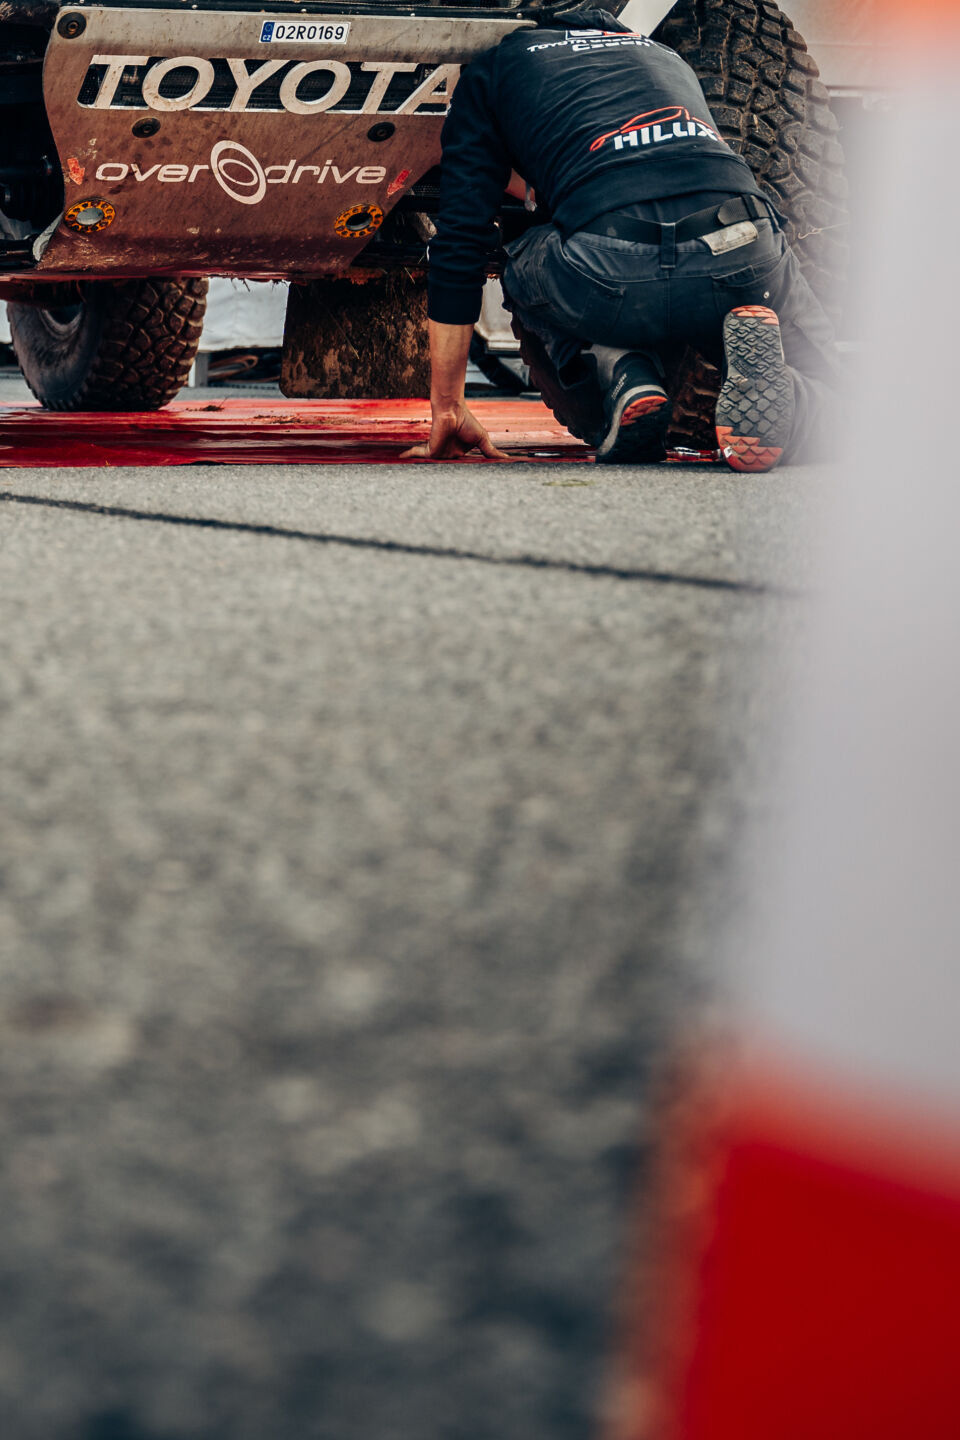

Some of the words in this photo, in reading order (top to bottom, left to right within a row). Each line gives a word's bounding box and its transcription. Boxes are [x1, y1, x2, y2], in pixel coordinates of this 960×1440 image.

[276, 25, 345, 40] 02R0169
[89, 55, 463, 116] TOYOTA
[614, 121, 719, 151] HILUX
